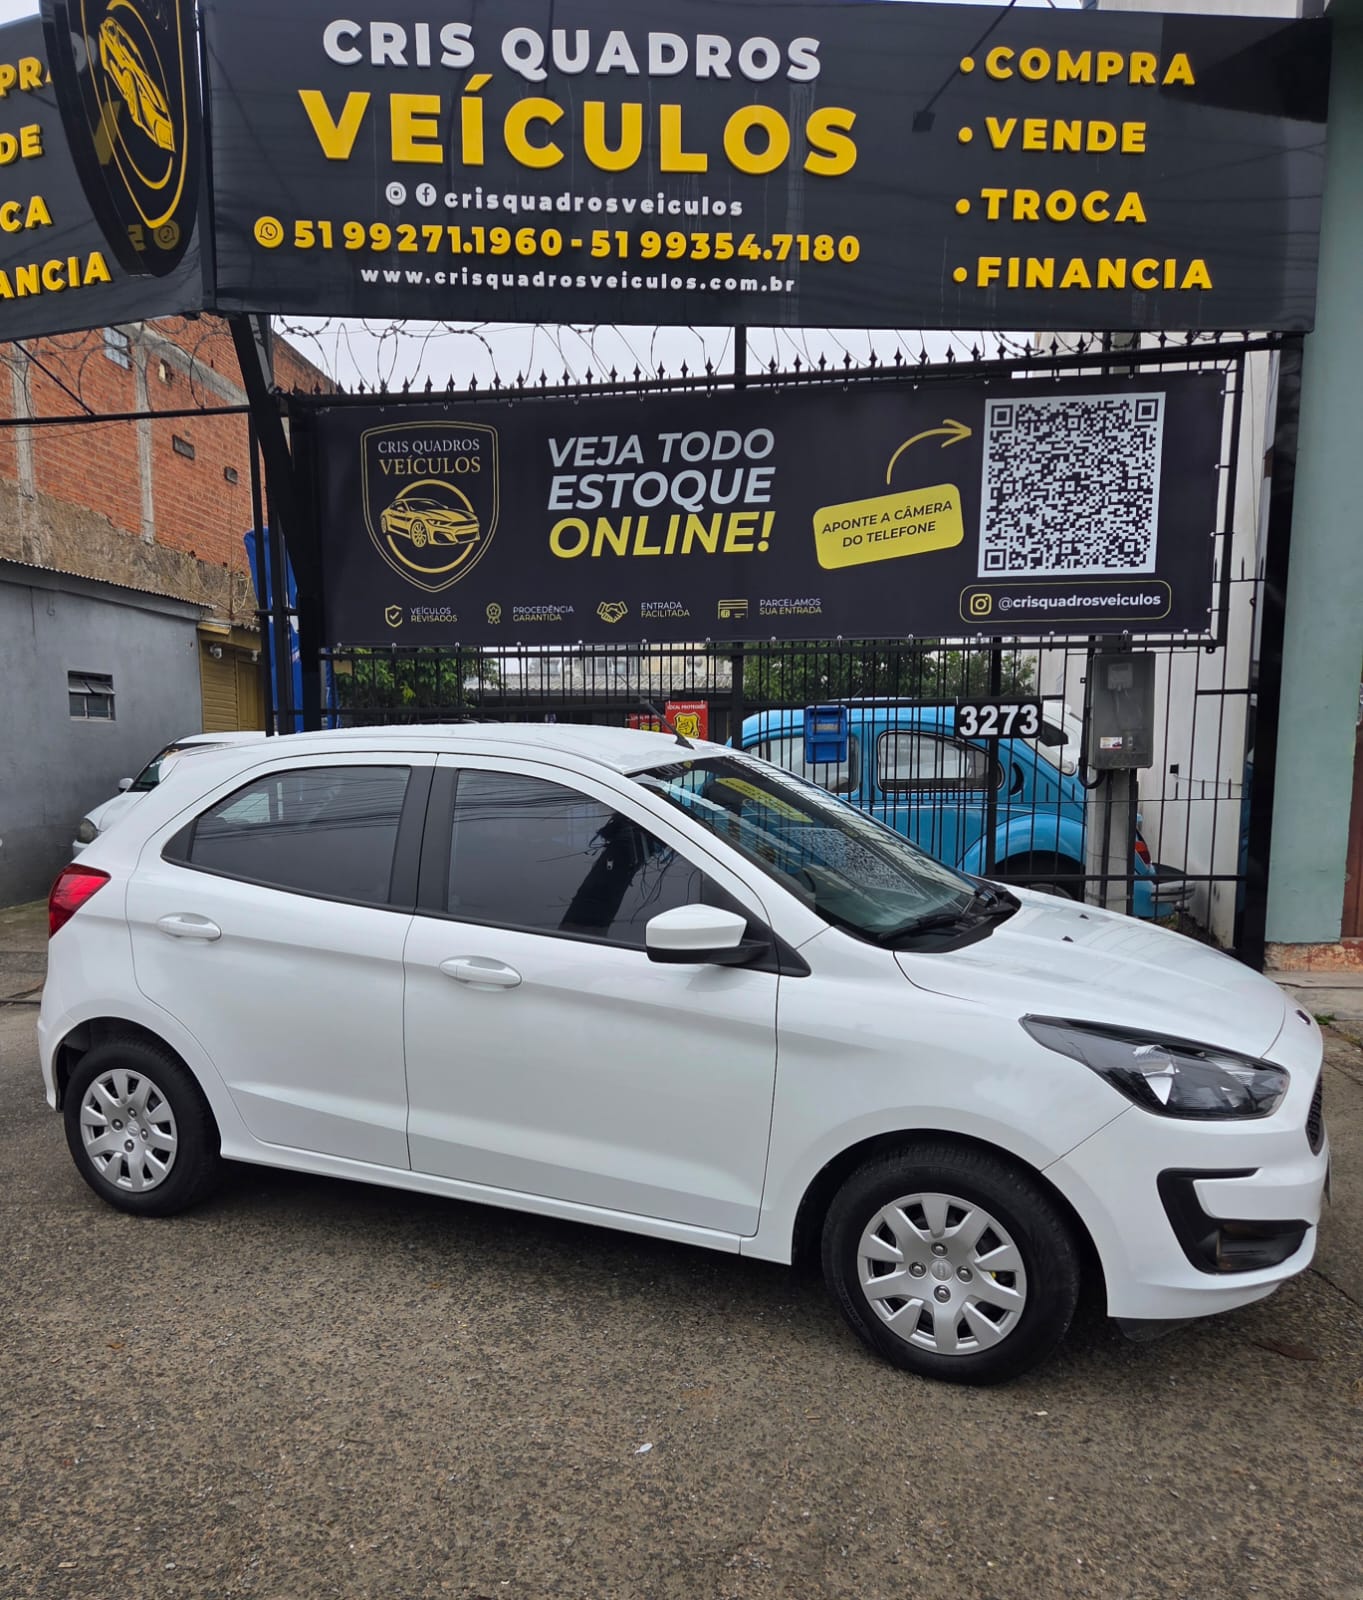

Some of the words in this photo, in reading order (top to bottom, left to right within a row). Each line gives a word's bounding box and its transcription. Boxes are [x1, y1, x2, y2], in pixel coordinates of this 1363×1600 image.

[322, 19, 475, 68] CRIS
[501, 27, 821, 82] QUADROS
[985, 46, 1196, 86] COMPRA
[298, 73, 857, 176] VEÍCULOS
[985, 116, 1147, 153] VENDE
[444, 187, 743, 216] crisquadrosveiculos
[980, 188, 1147, 223] TROCA
[294, 220, 333, 249] 51
[342, 221, 563, 257] 99271.1960
[590, 229, 629, 258] 51
[640, 230, 860, 263] 99354.7180
[360, 266, 795, 292] www.crisquadrosveiculos.com.br
[977, 256, 1213, 289] FINANCIA
[378, 440, 409, 454] CRIS
[412, 438, 480, 454] QUADROS
[548, 434, 644, 467] VEJA
[658, 428, 775, 464] TODO
[379, 455, 481, 475] VEÍCULOS
[548, 466, 776, 512] ESTOQUE
[822, 514, 878, 534] APONTE
[880, 512, 891, 523] A
[893, 500, 953, 520] CÂMERA
[548, 510, 776, 559] ONLINE!
[842, 534, 863, 547] DO
[866, 520, 937, 543] TELEFONE
[410, 606, 451, 615] VEÍCULOS
[513, 604, 575, 614] PROCEDÊNCIA
[641, 601, 683, 610] ENTRADA
[641, 609, 691, 618] FACILITADA
[759, 598, 821, 607] PARCELAMOS
[759, 606, 778, 615] SUA
[779, 606, 823, 615] ENTRADA
[998, 593, 1161, 611] @crisquadrosveiculos
[410, 614, 458, 623] REVISADOS
[513, 613, 562, 622] GARANTIDA
[959, 704, 1039, 736] 3273
